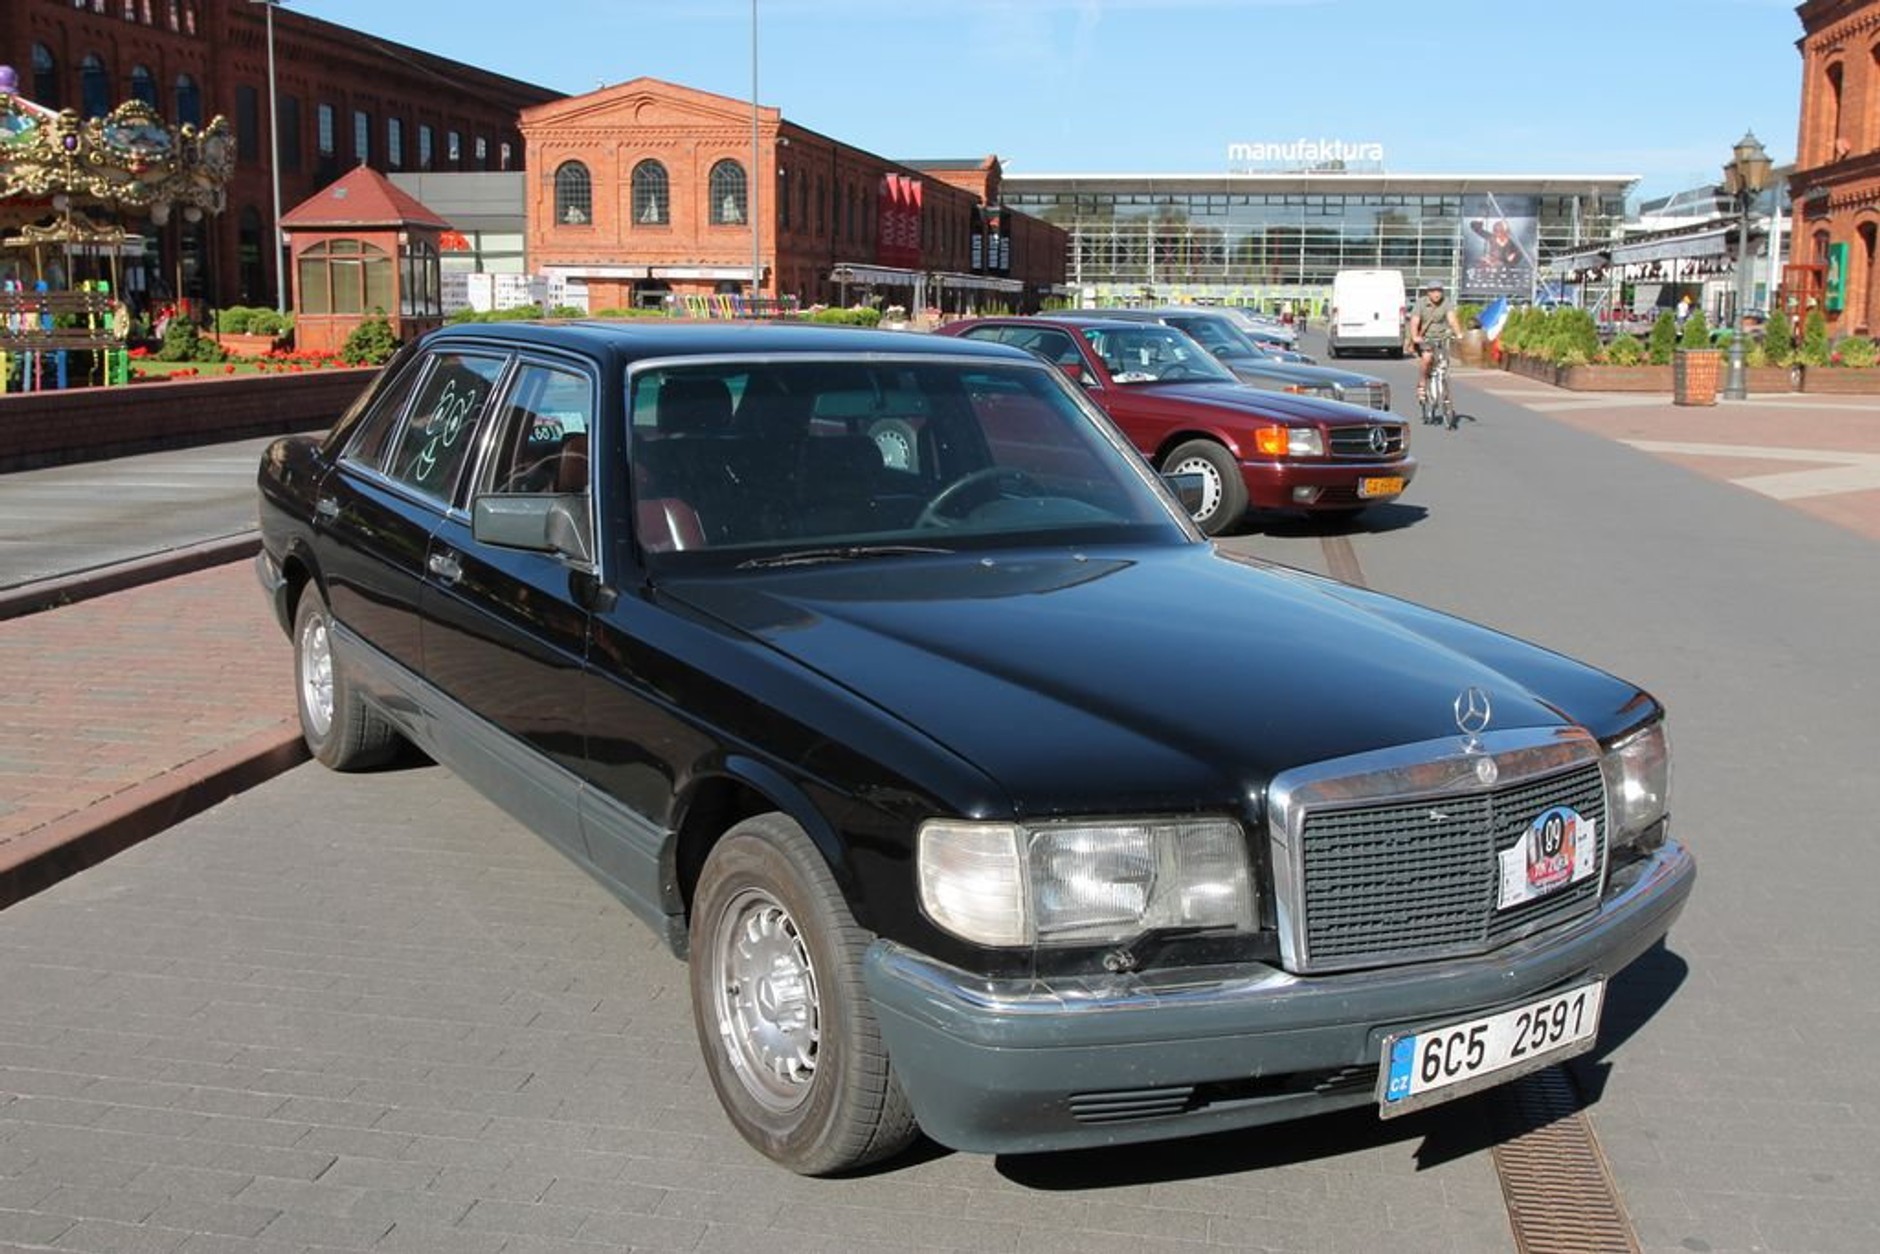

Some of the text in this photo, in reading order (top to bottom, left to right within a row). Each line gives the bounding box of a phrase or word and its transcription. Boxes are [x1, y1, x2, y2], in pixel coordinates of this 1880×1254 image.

[1228, 138, 1384, 161] manufaktura
[1421, 992, 1586, 1084] 6C5 2591
[1390, 1077, 1408, 1093] CZ
